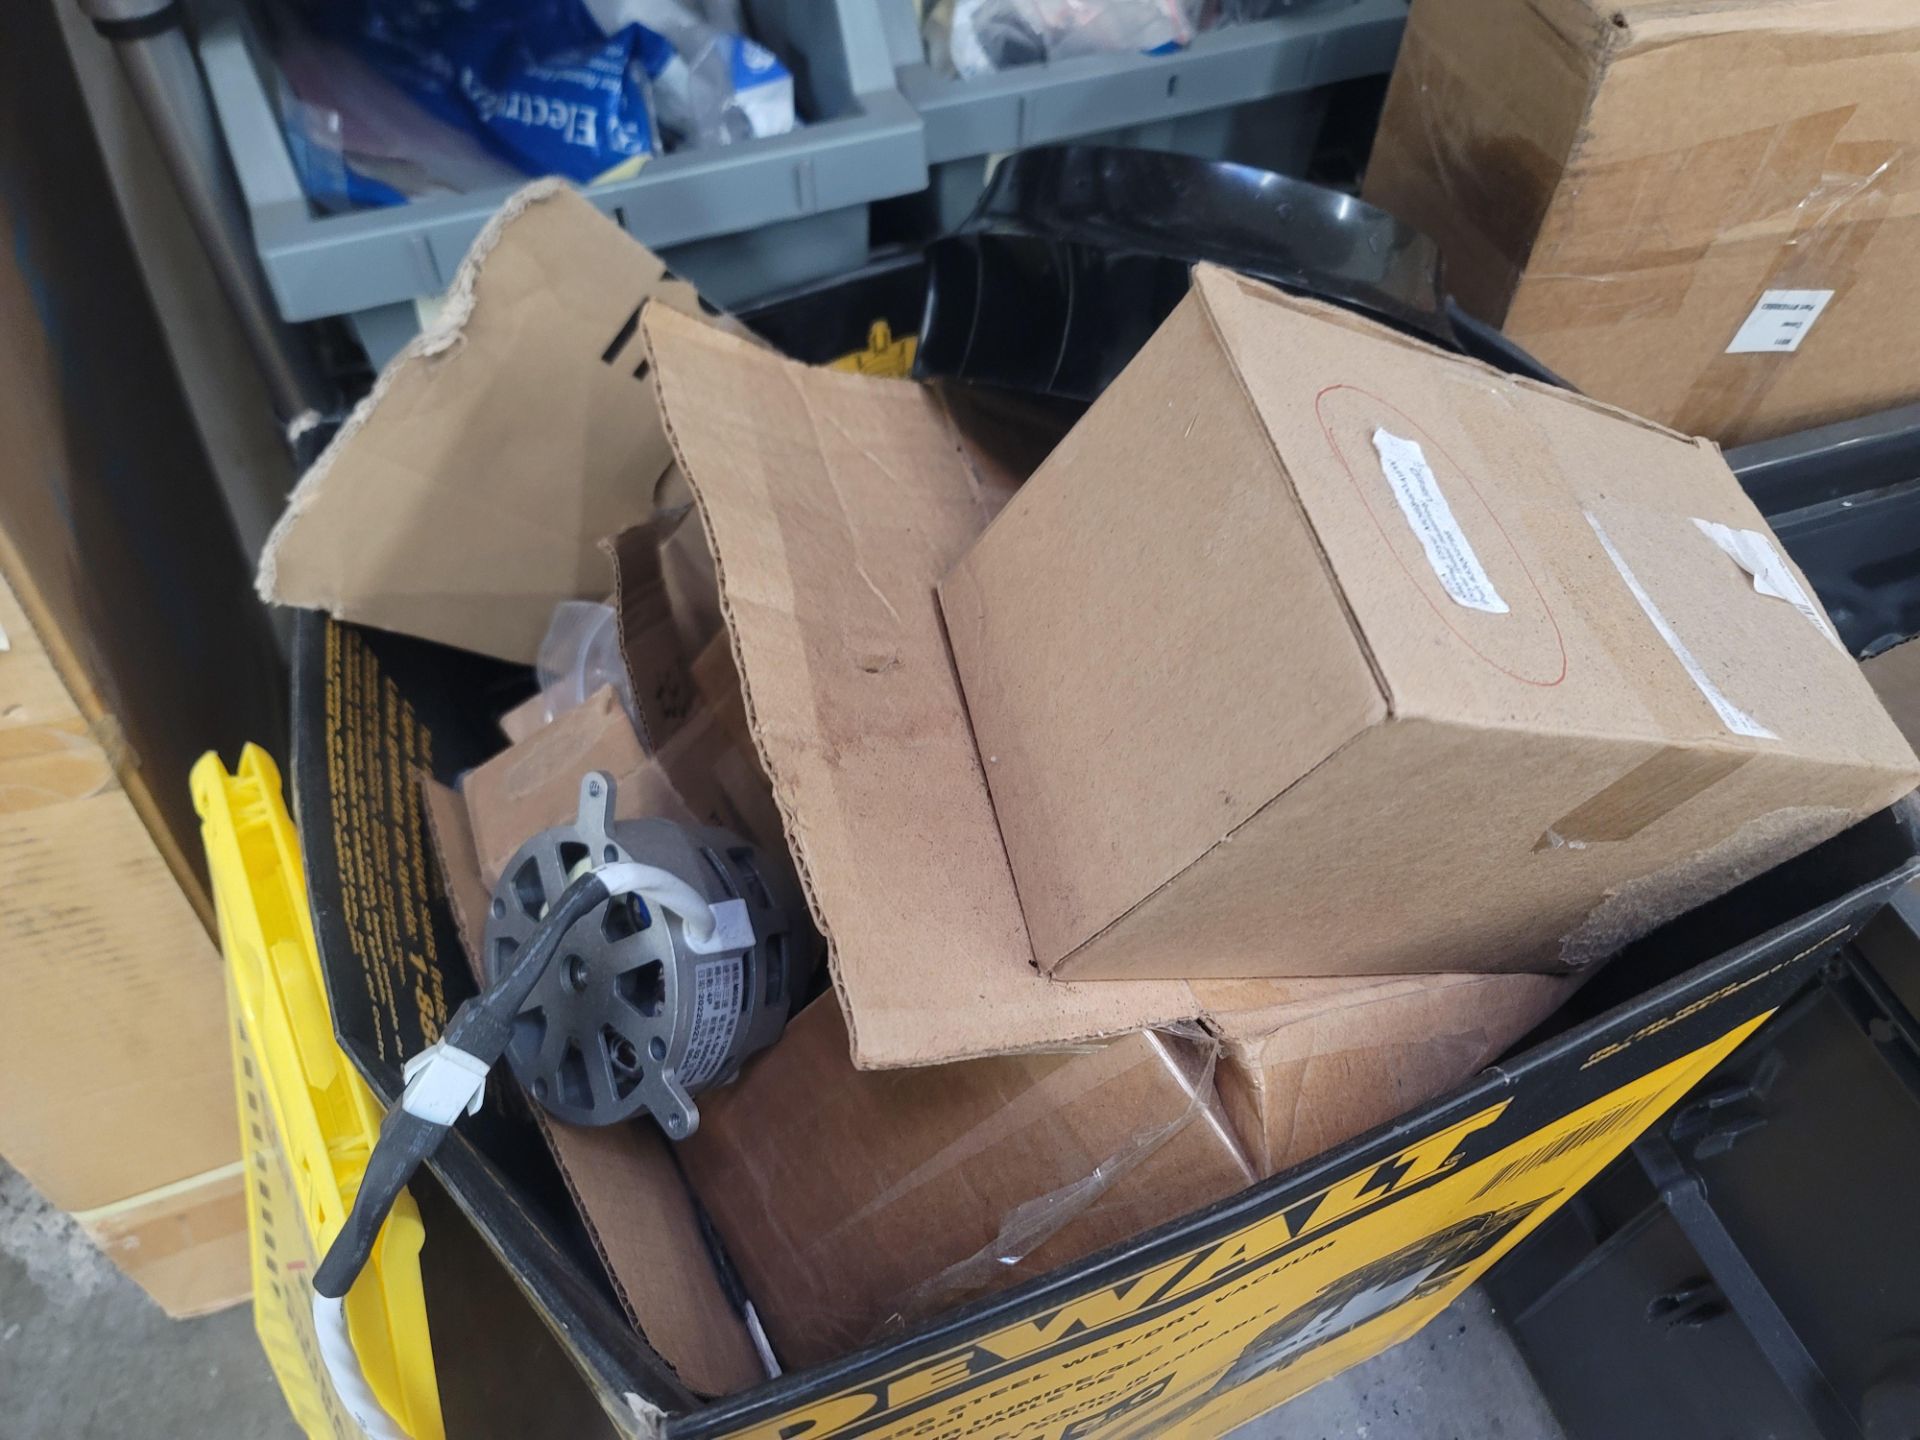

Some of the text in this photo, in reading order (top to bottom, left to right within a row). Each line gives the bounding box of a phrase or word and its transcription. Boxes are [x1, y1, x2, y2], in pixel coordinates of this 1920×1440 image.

[772, 1098, 1510, 1440] DEWALT
[947, 1373, 1050, 1416] STEEL
[1062, 1303, 1206, 1370] WET/DRY
[1215, 1239, 1337, 1304] VACUUM
[1173, 1320, 1211, 1344] EN
